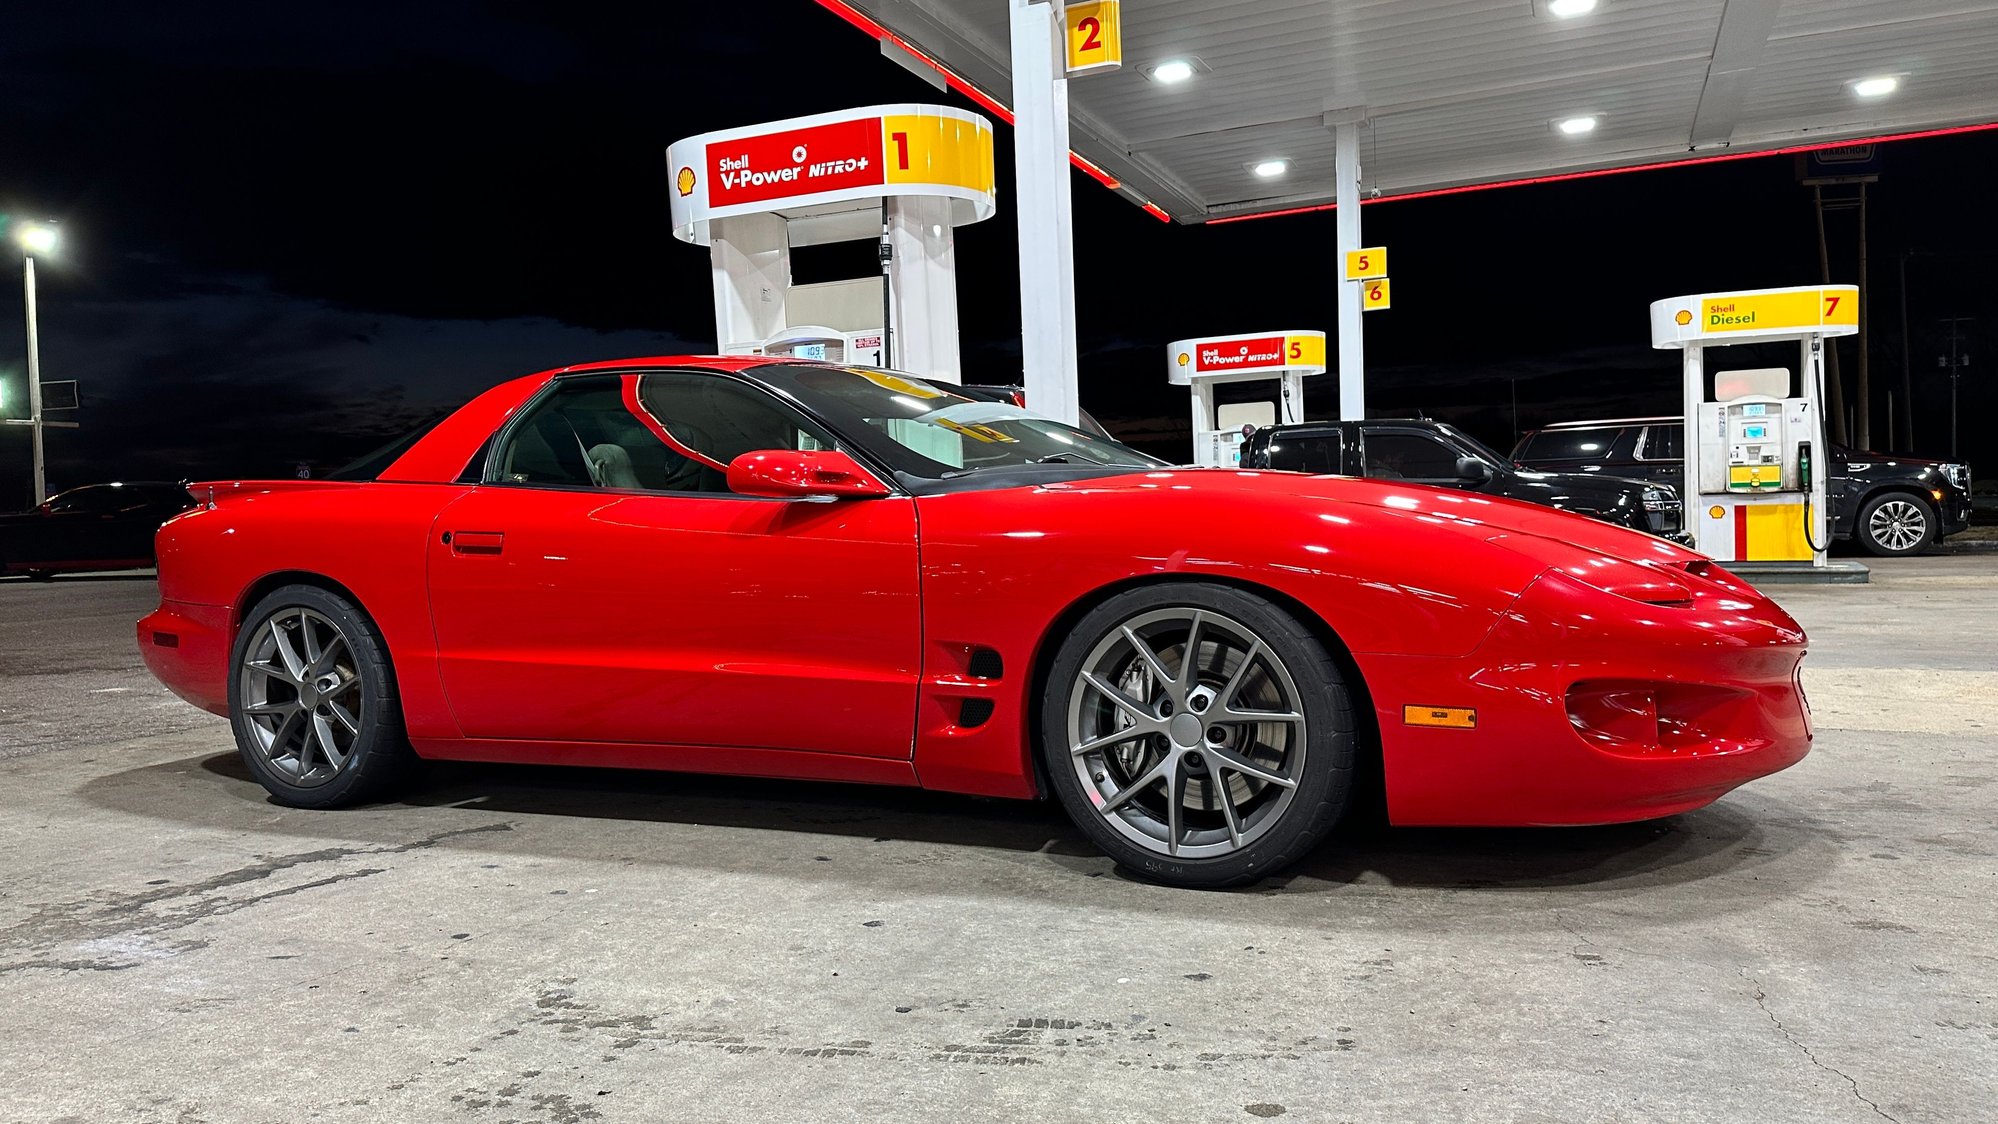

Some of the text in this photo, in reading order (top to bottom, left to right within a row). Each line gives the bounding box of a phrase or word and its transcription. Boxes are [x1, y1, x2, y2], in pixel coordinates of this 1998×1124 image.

[1078, 16, 1101, 52] 2
[892, 132, 909, 170] 1
[1821, 146, 1867, 156] MARATHON
[720, 154, 749, 172] Shell
[720, 166, 801, 190] V-Power
[1358, 256, 1369, 271] 5
[1369, 286, 1382, 301] 6
[1710, 304, 1735, 313] Shell
[1825, 297, 1840, 316] 7
[1711, 311, 1755, 325] Diesel
[1202, 349, 1219, 357] Shell
[1289, 342, 1302, 359] 5
[873, 350, 881, 367] 1
[1203, 354, 1245, 365] V-Power
[1800, 403, 1808, 412] 7
[297, 470, 310, 479] 40
